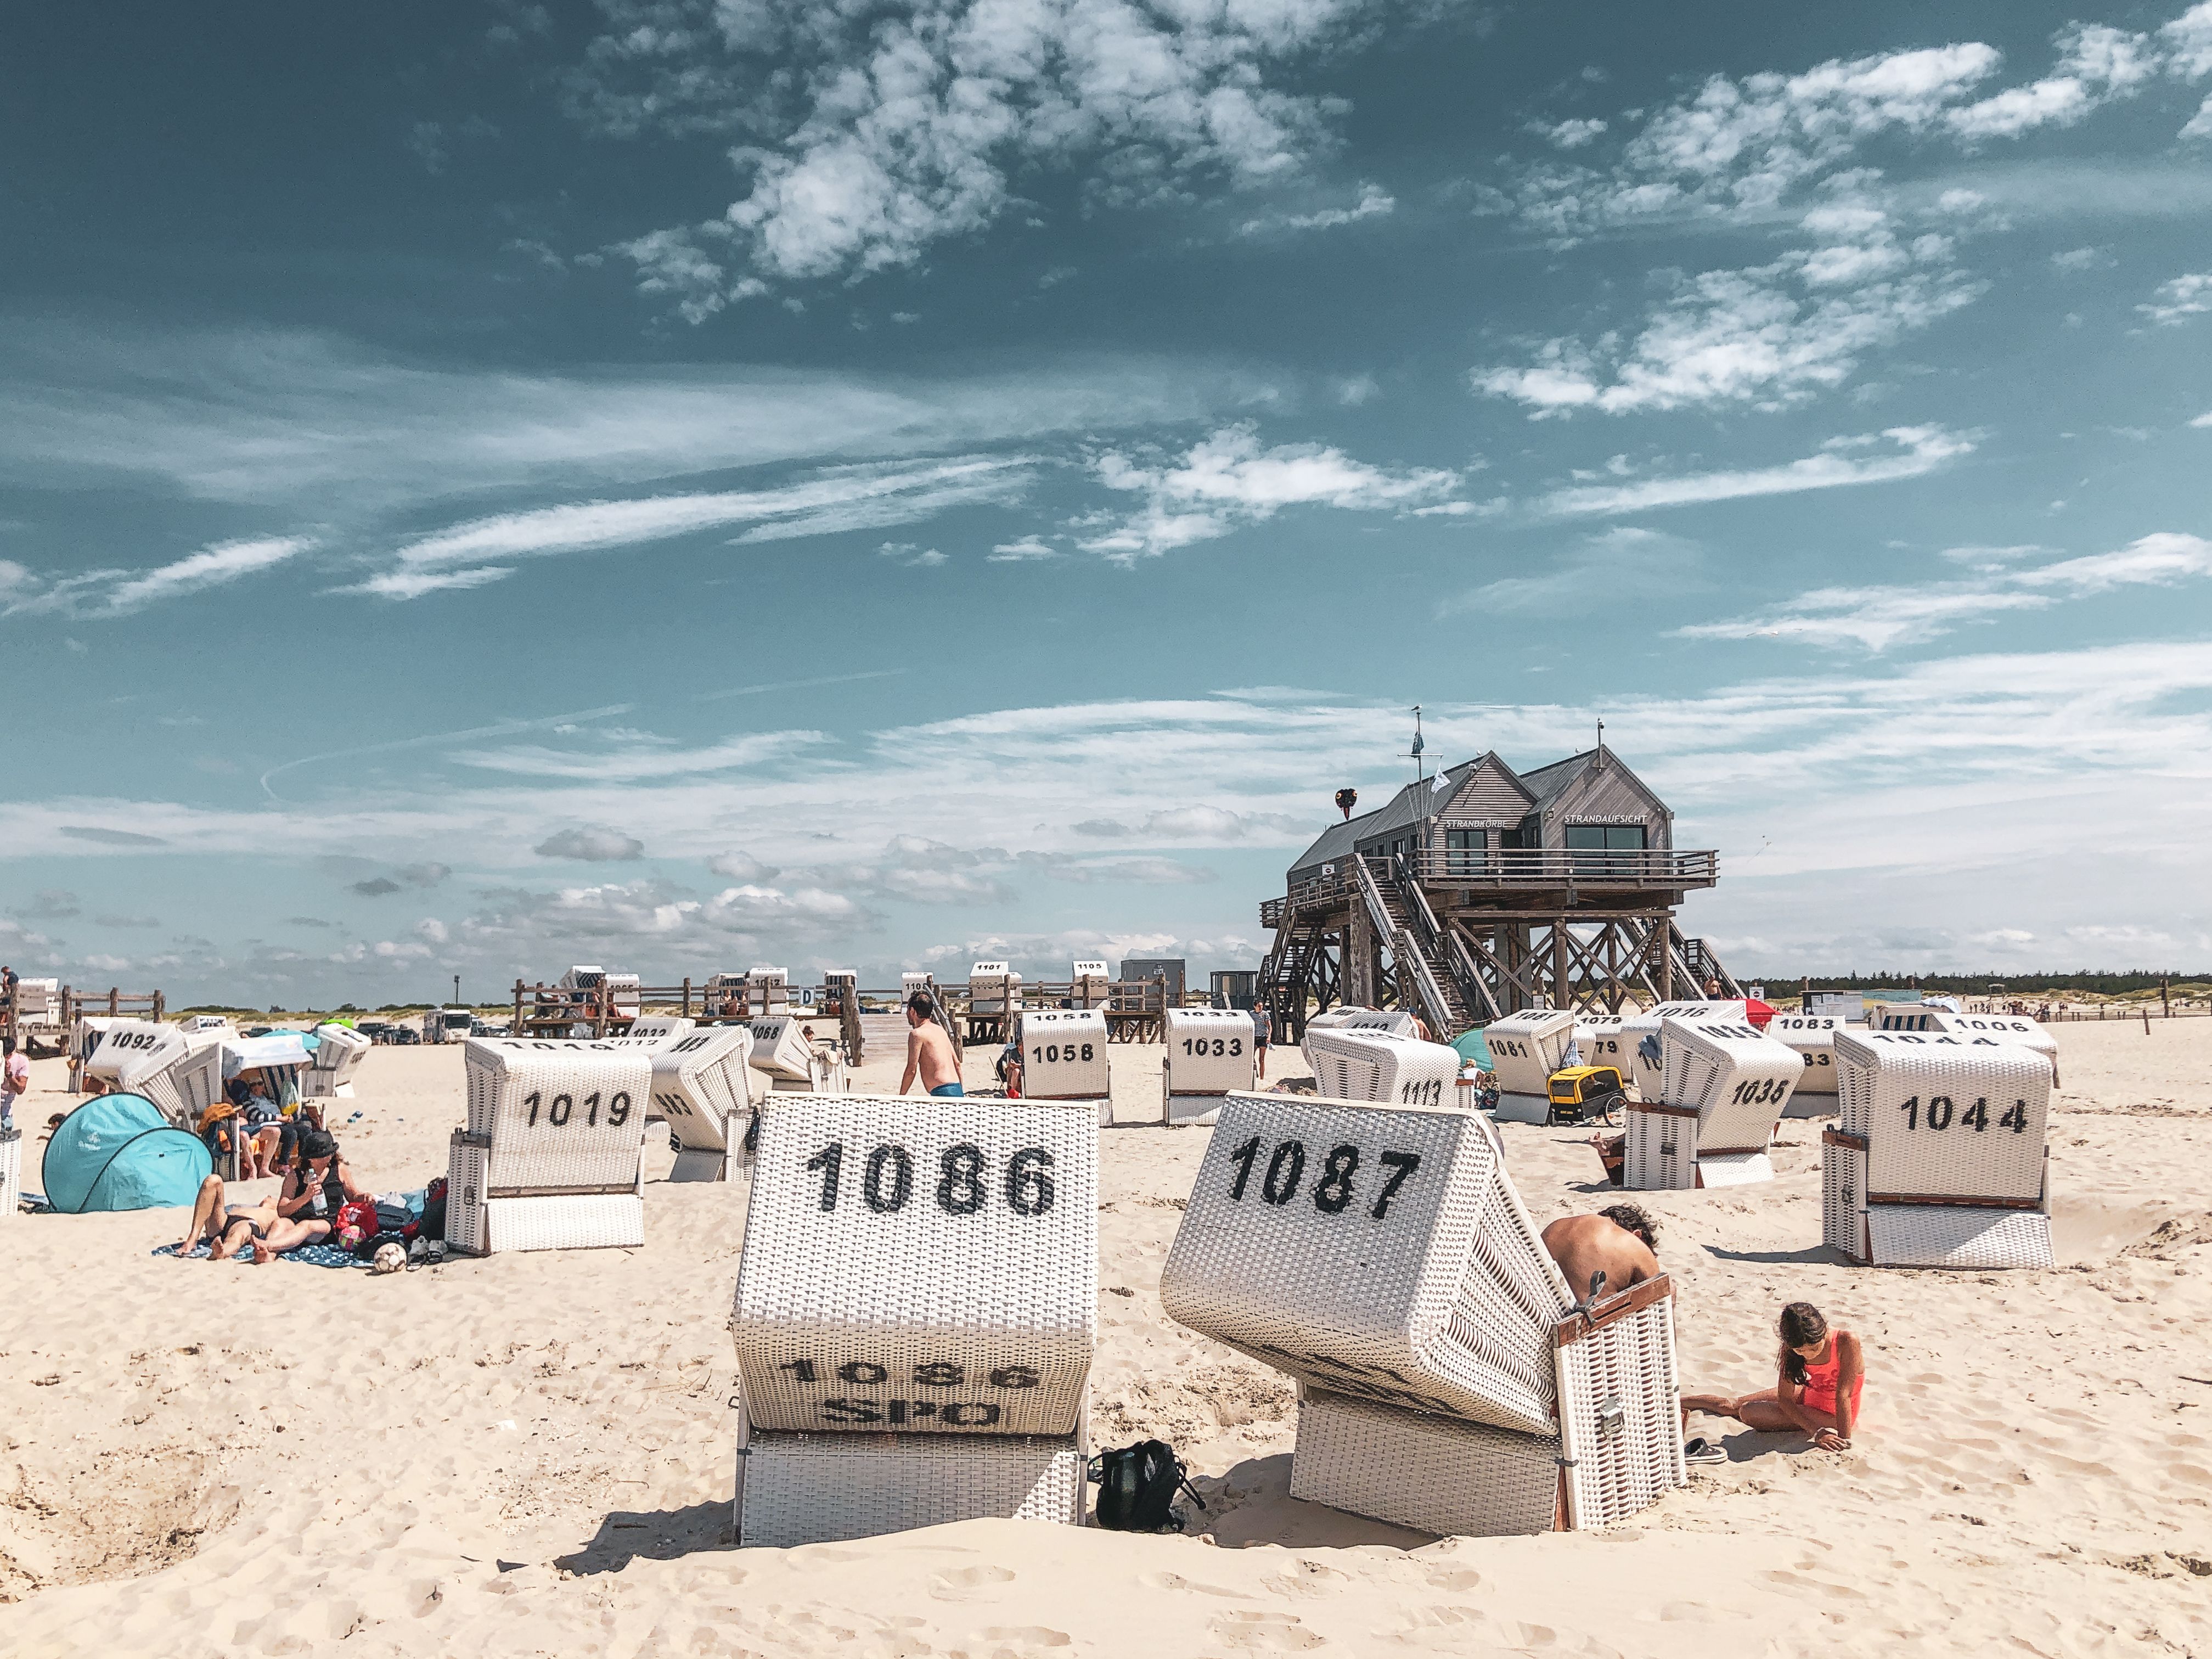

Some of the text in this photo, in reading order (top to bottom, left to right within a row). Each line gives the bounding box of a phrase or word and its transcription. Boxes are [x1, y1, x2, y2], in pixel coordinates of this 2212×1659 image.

[1445, 818, 1507, 828] STRANDKÖRBE
[1564, 814, 1648, 824] STRANDAUFSICHT
[803, 990, 811, 1004] D
[1033, 1013, 1091, 1021] 1058
[1515, 1012, 1557, 1021] 1081
[1580, 1016, 1622, 1025] 1079
[1780, 1019, 1834, 1030] 1083
[1955, 1019, 2029, 1032] 1006
[111, 1031, 156, 1050] 1092
[752, 1025, 780, 1040] 1068
[1696, 1025, 1763, 1039] 1035
[1032, 1043, 1094, 1064] 1058
[1182, 1038, 1243, 1057] 1033
[1488, 1039, 1528, 1059] 1081
[1402, 1079, 1442, 1106] 1113
[524, 1089, 632, 1128] 1019
[655, 1093, 694, 1116] 983
[1900, 1095, 2029, 1134] 1044
[804, 1141, 1056, 1216] 1086
[1229, 1137, 1421, 1220] 1087
[779, 1358, 1040, 1389] 1086
[823, 1398, 1001, 1426] SPO
